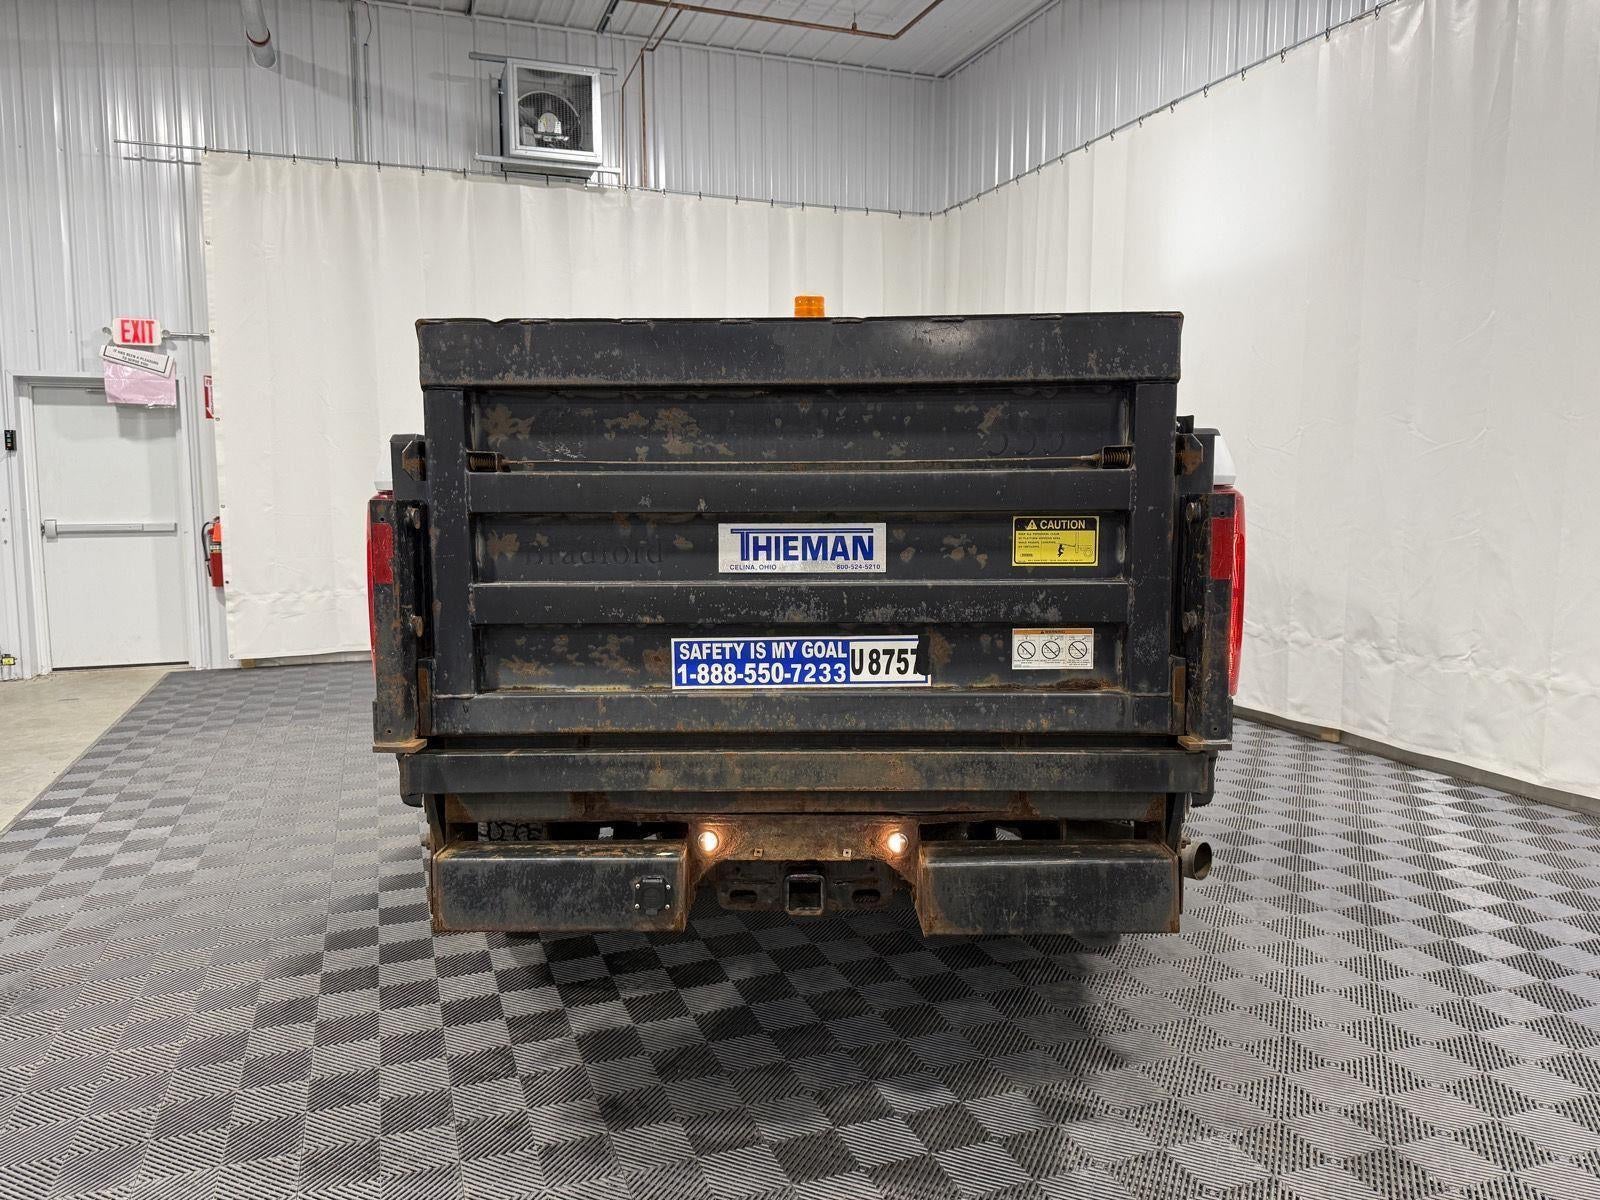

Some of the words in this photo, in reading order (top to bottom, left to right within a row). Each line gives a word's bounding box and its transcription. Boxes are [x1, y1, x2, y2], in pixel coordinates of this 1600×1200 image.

[121, 319, 155, 344] EXIT
[1039, 519, 1086, 530] CAUTION
[730, 528, 874, 562] THIEMAN
[679, 642, 745, 661] SAFETY
[750, 641, 767, 659] IS
[771, 641, 798, 659] MY
[801, 640, 848, 659] GOAL
[677, 662, 847, 685] 1-888-550-7233
